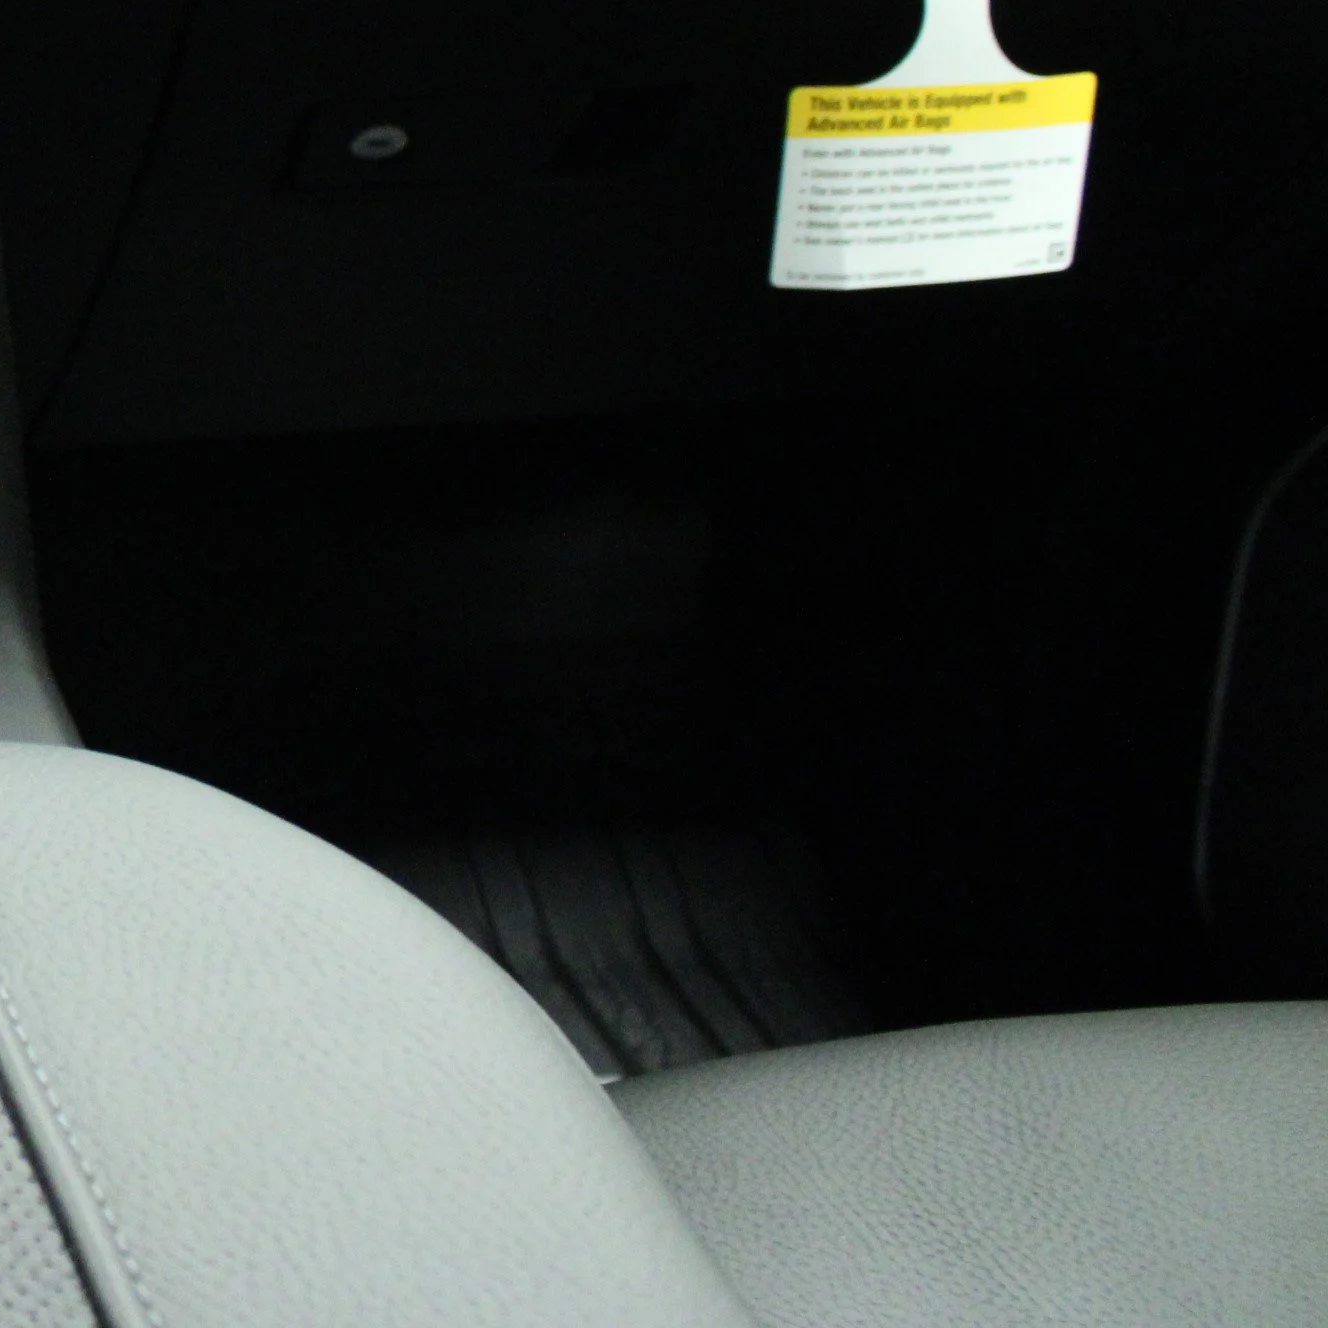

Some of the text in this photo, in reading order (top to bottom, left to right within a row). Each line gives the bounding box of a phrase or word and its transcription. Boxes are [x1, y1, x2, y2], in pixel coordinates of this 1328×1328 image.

[810, 96, 842, 111] This
[848, 95, 902, 111] Vehicle
[925, 92, 993, 110] Equipped
[807, 115, 885, 132] Advanced
[888, 114, 910, 129] Air
